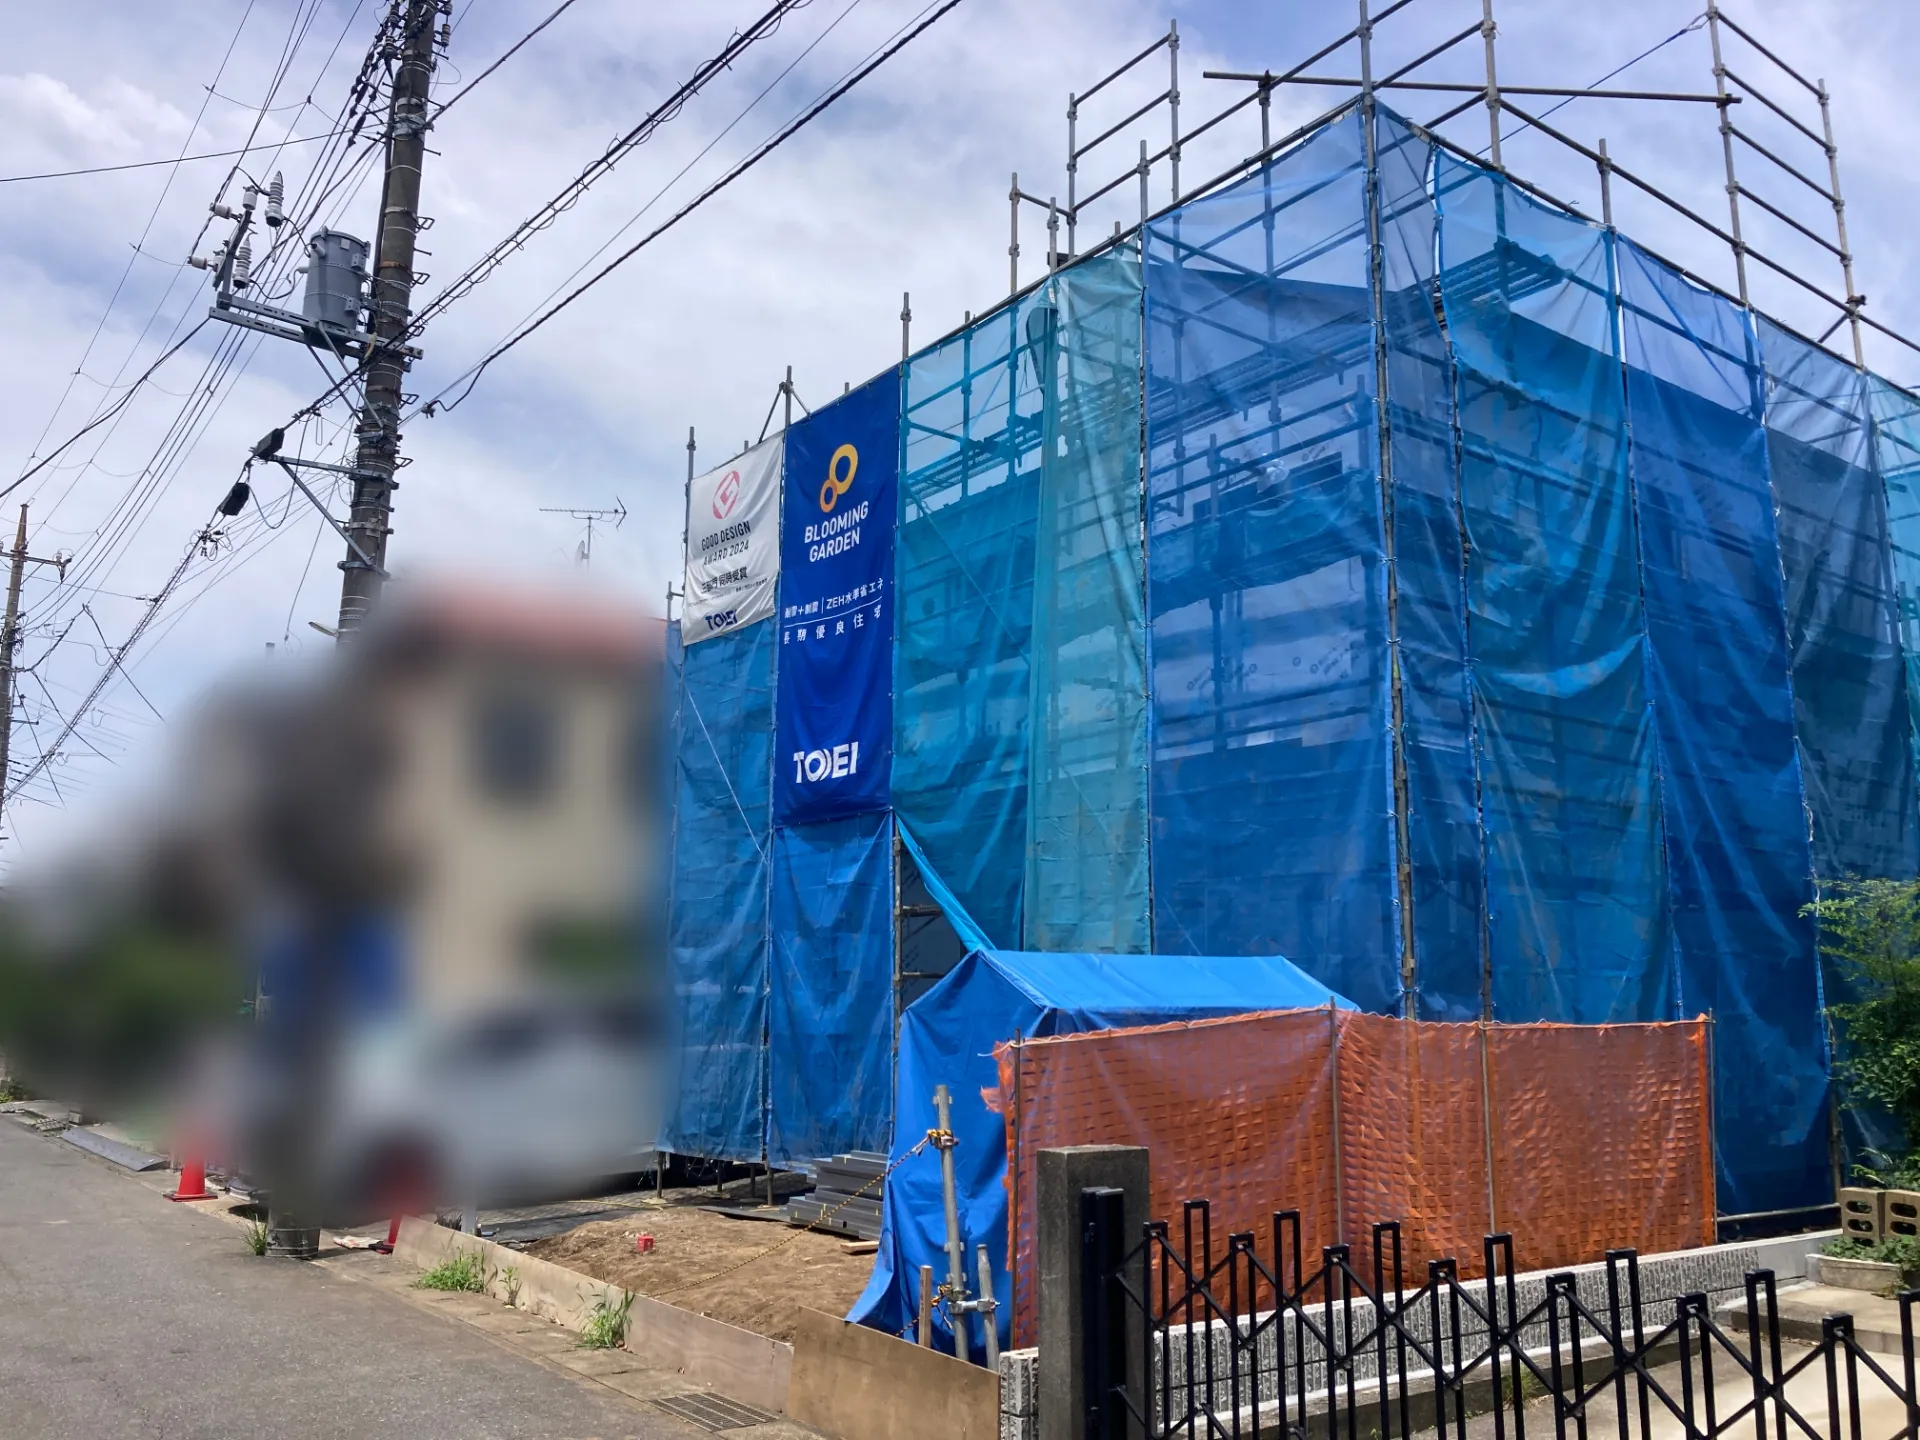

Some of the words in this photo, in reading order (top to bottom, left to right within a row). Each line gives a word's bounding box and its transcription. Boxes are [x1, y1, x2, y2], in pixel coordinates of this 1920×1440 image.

[702, 533, 719, 551] GOOD
[721, 521, 751, 543] DESIGN
[804, 501, 869, 543] BLOOMING
[703, 549, 728, 567] AWARD
[729, 540, 750, 556] 2024
[809, 527, 860, 562] GARDEN
[793, 741, 859, 784] TOEI
